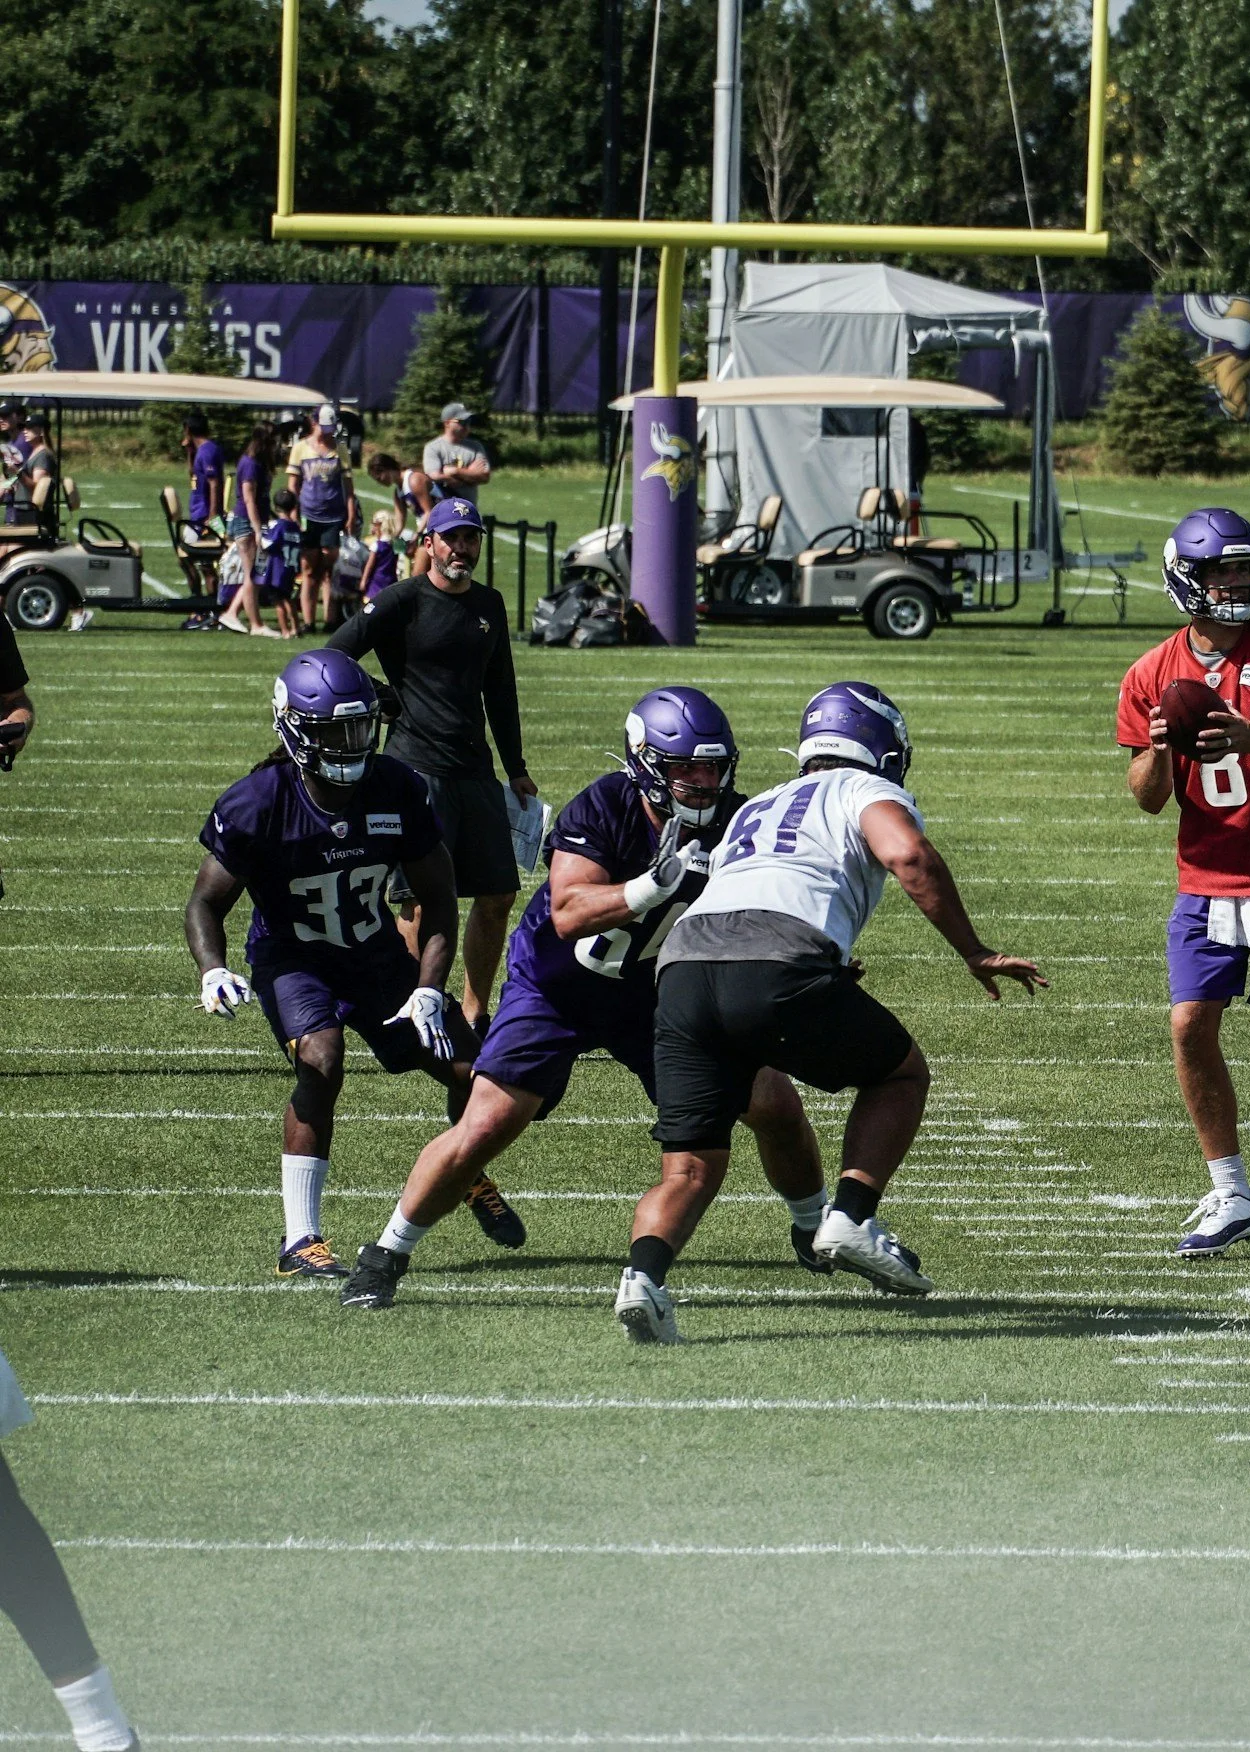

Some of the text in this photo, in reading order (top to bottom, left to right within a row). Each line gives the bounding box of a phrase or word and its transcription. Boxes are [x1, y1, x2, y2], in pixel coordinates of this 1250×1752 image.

[75, 303, 234, 315] MINNESTA
[91, 320, 282, 379] VIKGS
[368, 819, 402, 830] verizon
[690, 856, 710, 869] veri
[289, 863, 389, 949] 33
